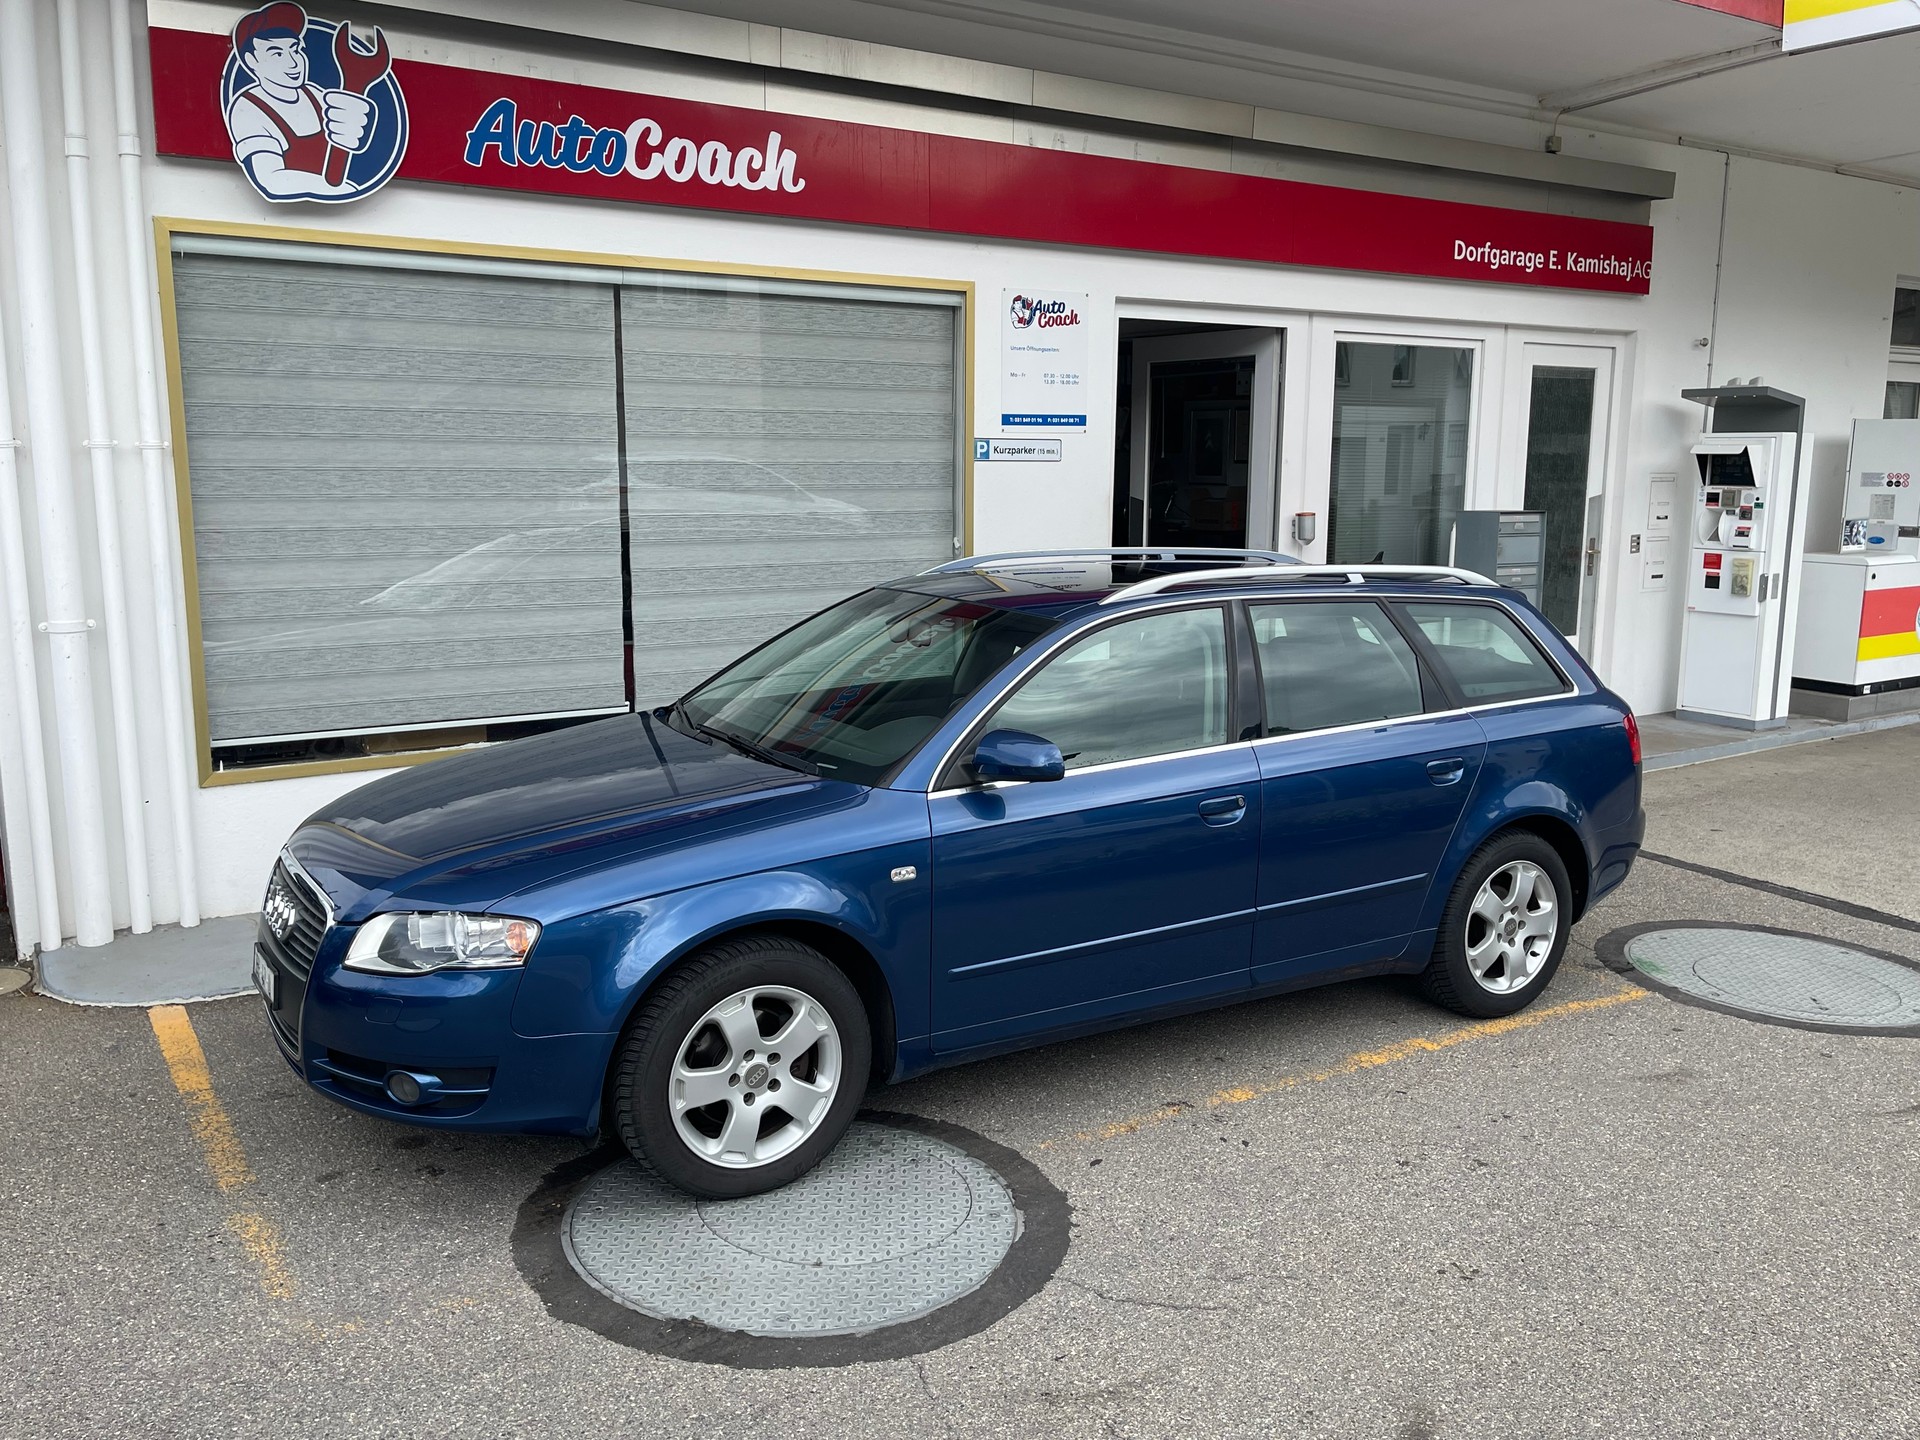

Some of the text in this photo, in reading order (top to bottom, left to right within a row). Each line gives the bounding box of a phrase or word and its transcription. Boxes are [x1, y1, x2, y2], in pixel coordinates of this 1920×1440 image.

[1454, 239, 1544, 272] Dorfgarage
[1548, 250, 1561, 270] E.
[1033, 299, 1066, 317] Auto
[1038, 308, 1081, 328] Coach
[976, 441, 988, 459] P
[993, 445, 1036, 456] Kurzparker
